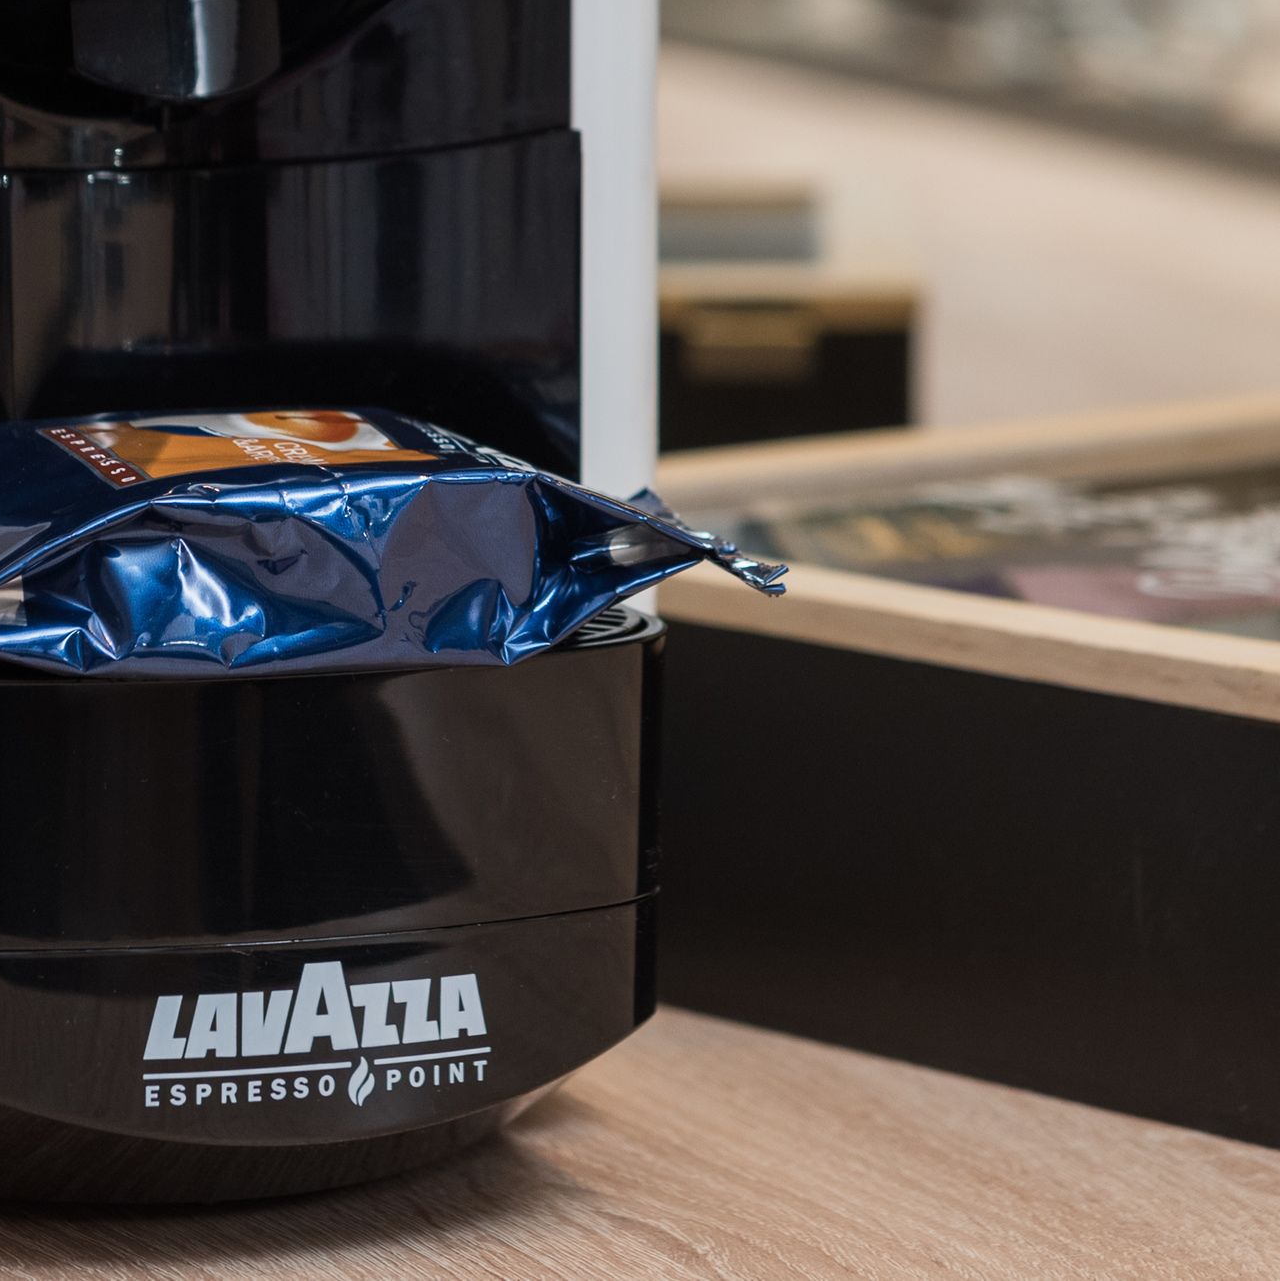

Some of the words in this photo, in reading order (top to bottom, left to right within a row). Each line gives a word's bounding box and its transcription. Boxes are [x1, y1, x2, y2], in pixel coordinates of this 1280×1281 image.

[143, 960, 488, 1061] LAVAZZA
[144, 1074, 336, 1108] ESPRESSO
[386, 1059, 488, 1091] POINT
